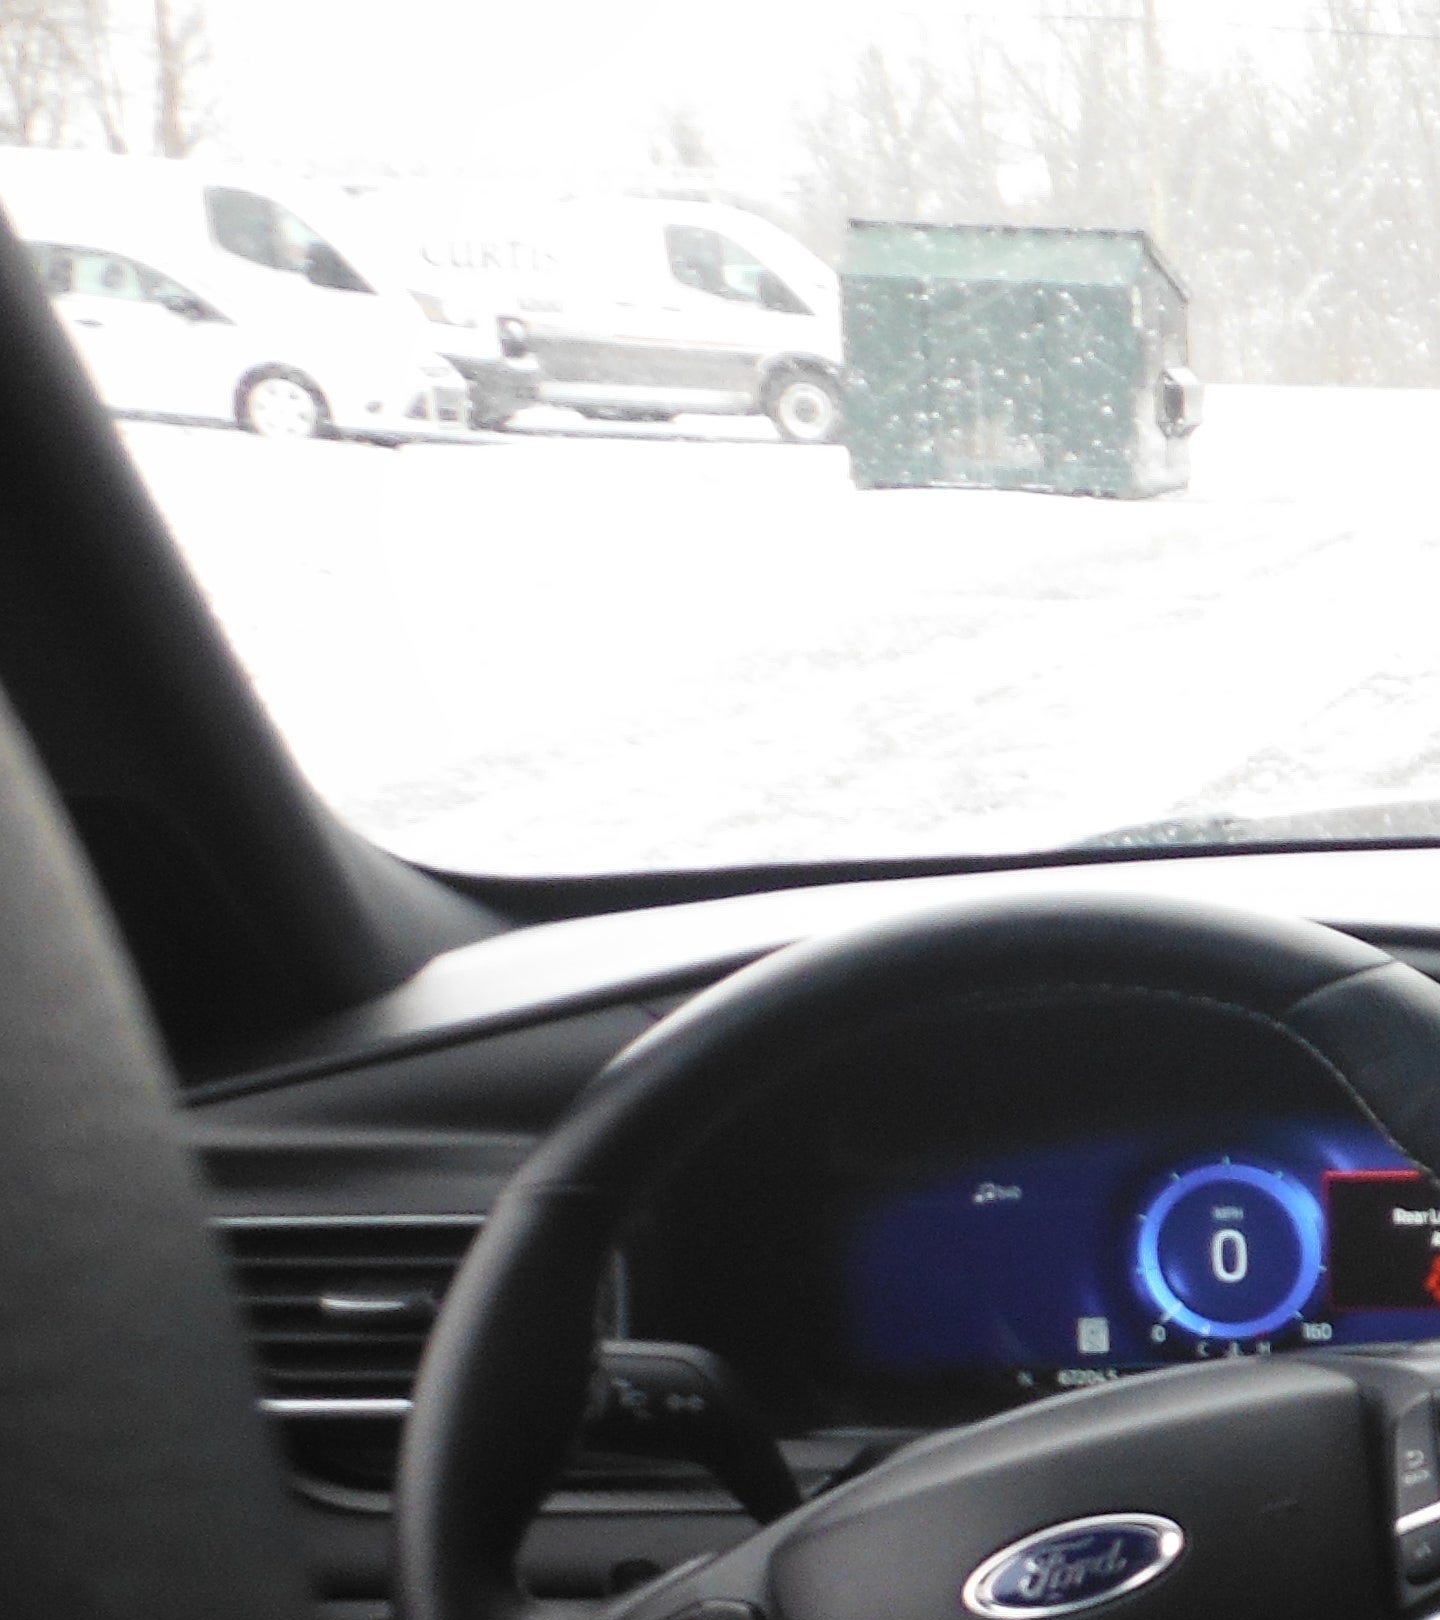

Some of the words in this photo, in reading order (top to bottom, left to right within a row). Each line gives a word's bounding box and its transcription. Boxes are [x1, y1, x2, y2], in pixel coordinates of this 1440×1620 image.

[419, 241, 558, 270] CURTIS
[1392, 1207, 1429, 1225] Rear
[1212, 1228, 1247, 1283] 0
[1018, 1535, 1128, 1599] Ford
